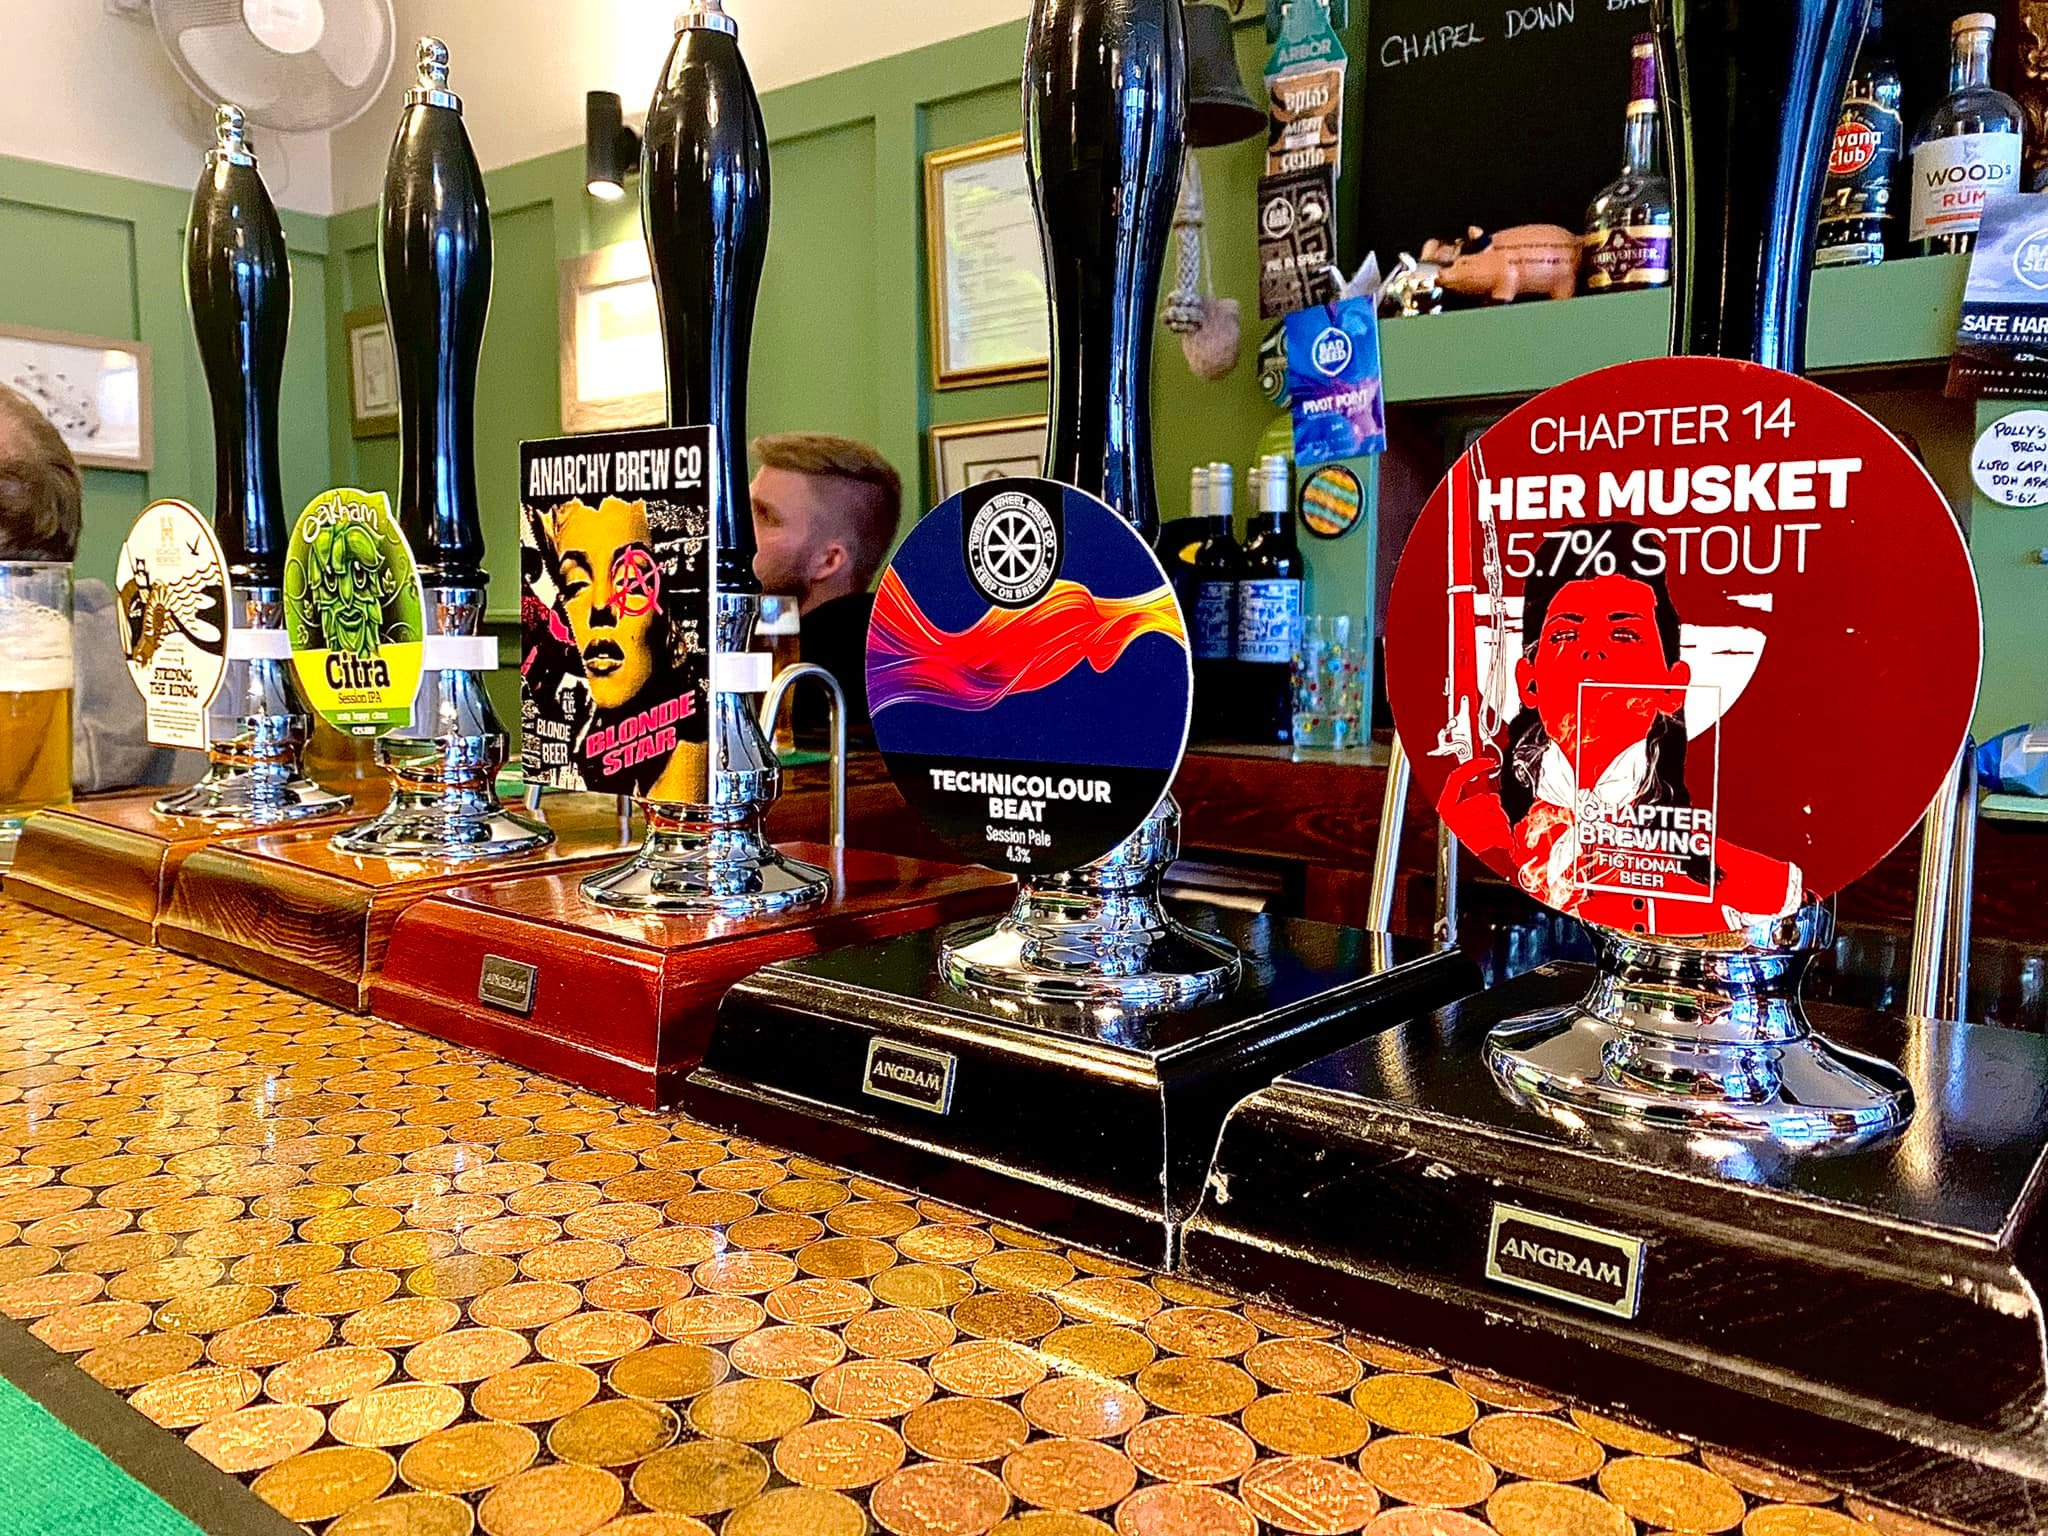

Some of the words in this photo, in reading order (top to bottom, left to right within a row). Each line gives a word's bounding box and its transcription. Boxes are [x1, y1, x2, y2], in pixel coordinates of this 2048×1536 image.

[1380, 23, 1485, 68] CHAPEL
[1504, 0, 1575, 39] DOWN
[1278, 38, 1332, 66] ARBOR
[1831, 131, 1882, 149] vana
[1828, 148, 1866, 167] Club
[1943, 190, 1986, 207] RUM
[1962, 314, 2009, 333] SAFE
[2012, 315, 2048, 334] HAR
[1318, 339, 1345, 353] BAD
[1318, 350, 1347, 365] SEED
[1302, 396, 1334, 416] PIVOT
[1335, 389, 1369, 411] POINT
[1530, 403, 1729, 455] CHAPTER
[1742, 397, 1796, 441] 14
[1994, 422, 2046, 439] POLLY'S
[2010, 440, 2047, 453] BREW
[529, 452, 611, 497] ANARCHY
[615, 448, 670, 493] BREW
[674, 445, 702, 480] CO
[1476, 473, 1587, 522] HER
[1598, 457, 1863, 517] MUSKET
[302, 495, 379, 543] Oakham
[969, 505, 994, 552] TWISTED
[992, 495, 1026, 510] WHEEL
[1026, 500, 1050, 529] BREW
[1504, 527, 1617, 579] 5.7%
[1631, 522, 1822, 577] STOUT
[975, 564, 998, 593] KEEP
[998, 589, 1013, 599] ON
[325, 651, 391, 690] Citra
[536, 717, 572, 743] BLONDE
[585, 689, 697, 760] BLONDE
[541, 742, 569, 765] BEER
[602, 726, 677, 777] STAR
[929, 768, 1112, 803] TECHNICOLOUR
[989, 797, 1046, 822] BEAT
[1579, 800, 1712, 832] CHAPTER
[985, 824, 1026, 845] Session
[1028, 828, 1051, 847] Pale
[1578, 822, 1711, 857] BREWING
[1005, 844, 1031, 864] 4.3%
[1599, 853, 1688, 875] FICTIONAL
[1619, 870, 1664, 888] BEER
[872, 1060, 941, 1091] ANGRAM
[1500, 1237, 1623, 1287] ANGRAM
